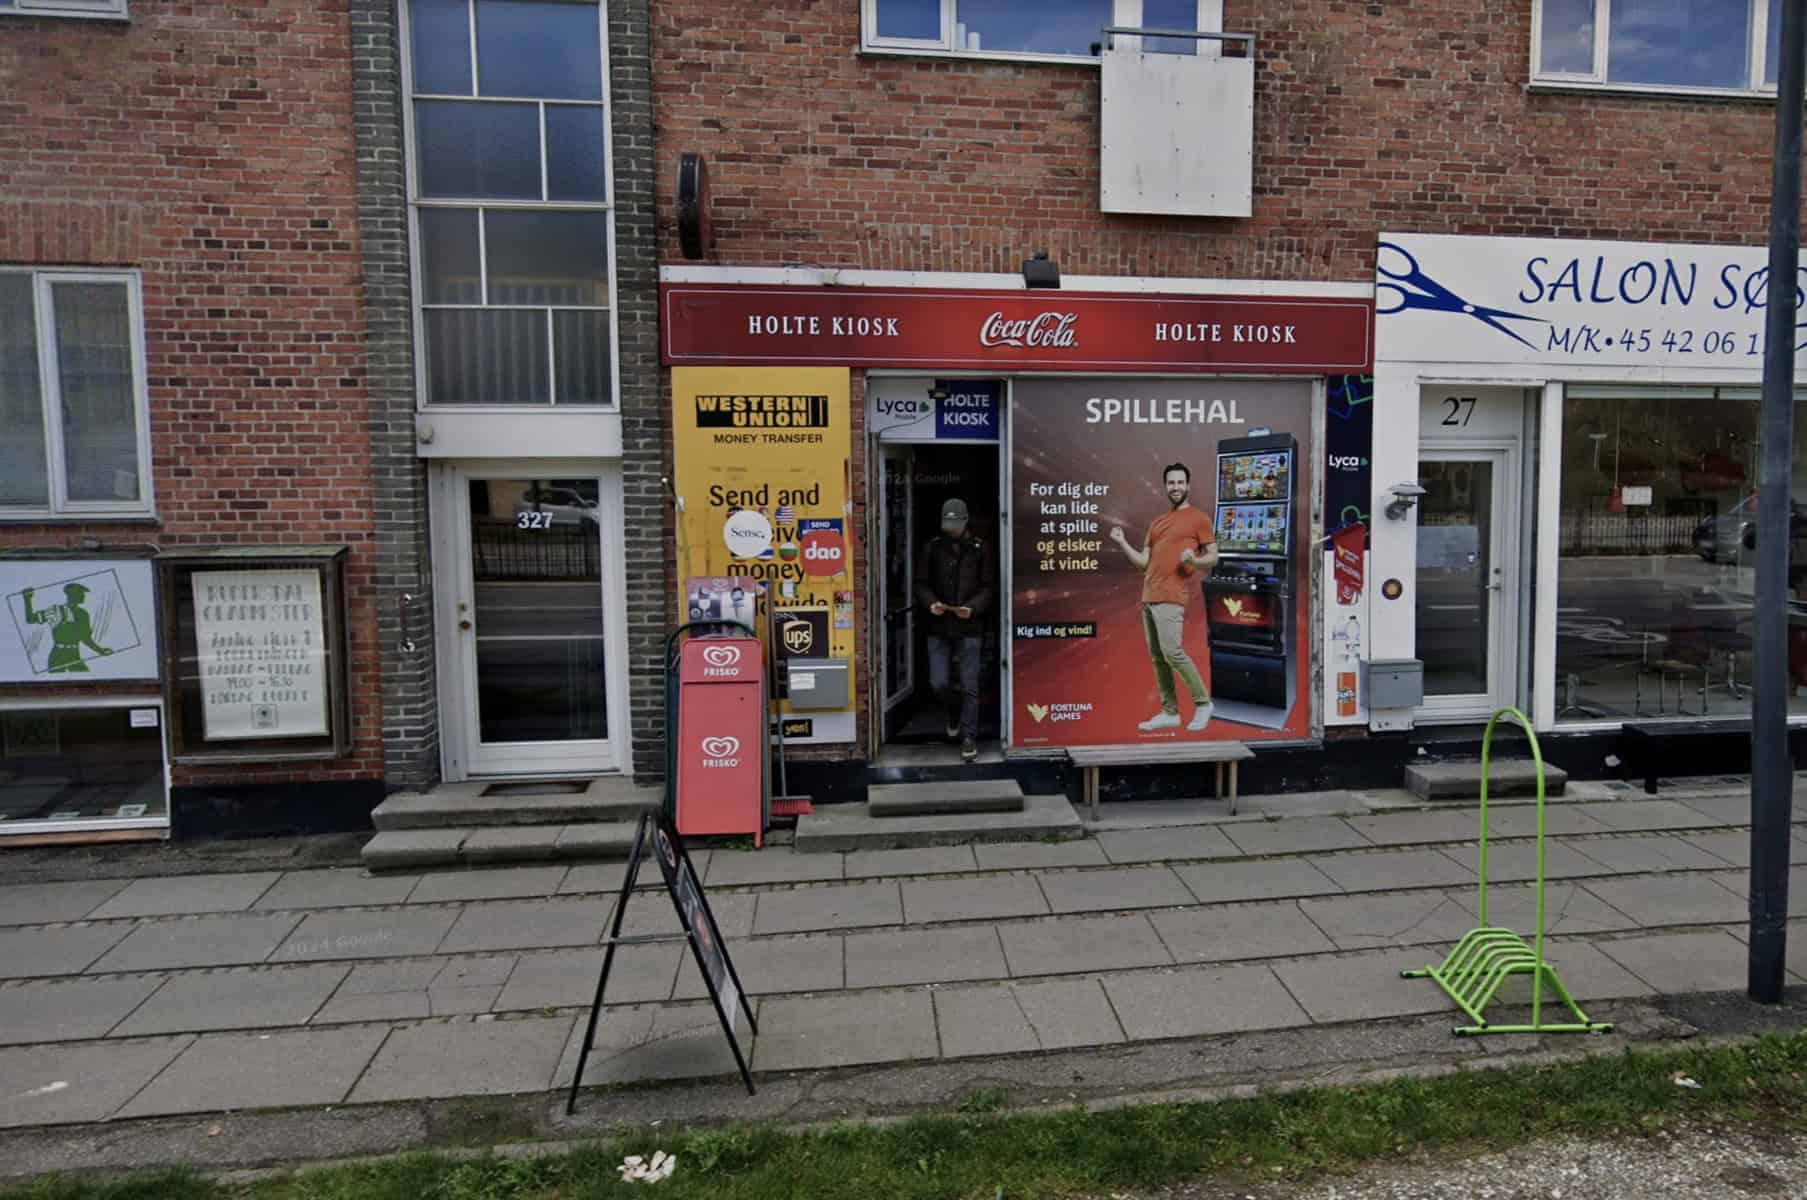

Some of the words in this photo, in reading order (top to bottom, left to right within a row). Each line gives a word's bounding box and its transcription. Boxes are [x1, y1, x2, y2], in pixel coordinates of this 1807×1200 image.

[1519, 255, 1697, 306] SALON
[749, 315, 820, 336] HOLTE
[832, 316, 899, 337] KIOSK
[980, 311, 1077, 348] Coca-Cola
[1155, 322, 1222, 343] HOLTE
[1233, 324, 1296, 344] KIOSK
[1661, 330, 1694, 354] 42
[1703, 331, 1736, 355] 06
[697, 397, 807, 411] WESTERN
[876, 397, 917, 415] Lyca
[943, 393, 990, 407] HOLTE
[732, 411, 807, 426] UNION
[943, 412, 990, 426] KIOSK
[1085, 398, 1245, 424] SPILLEHAL
[1441, 396, 1478, 427] 27
[713, 434, 758, 444] MONEY
[761, 434, 823, 444] TRANSFER
[1328, 454, 1359, 469] Lyca
[709, 483, 769, 507] Send
[778, 482, 820, 506] and
[1030, 483, 1054, 496] For
[1057, 482, 1081, 499] dig
[1085, 482, 1109, 496] der
[1040, 501, 1067, 515] kan
[1071, 500, 1098, 515] lide
[517, 511, 553, 529] 327
[1040, 521, 1056, 534] at
[1058, 519, 1098, 536] spille
[805, 541, 841, 560] dao
[1037, 541, 1055, 555] og
[1058, 538, 1102, 552] elsker
[1040, 558, 1056, 571] at
[1058, 557, 1099, 571] vinde
[727, 562, 805, 585] money
[786, 630, 811, 649] ups
[1017, 625, 1034, 638] Kig
[1035, 625, 1052, 636] ind
[1053, 626, 1067, 638] og
[1068, 624, 1093, 636] vind!
[703, 667, 739, 677] FRISKO
[1050, 703, 1093, 712] FORTUNA
[1050, 712, 1081, 722] GAMES
[703, 758, 739, 768] FRISKO
